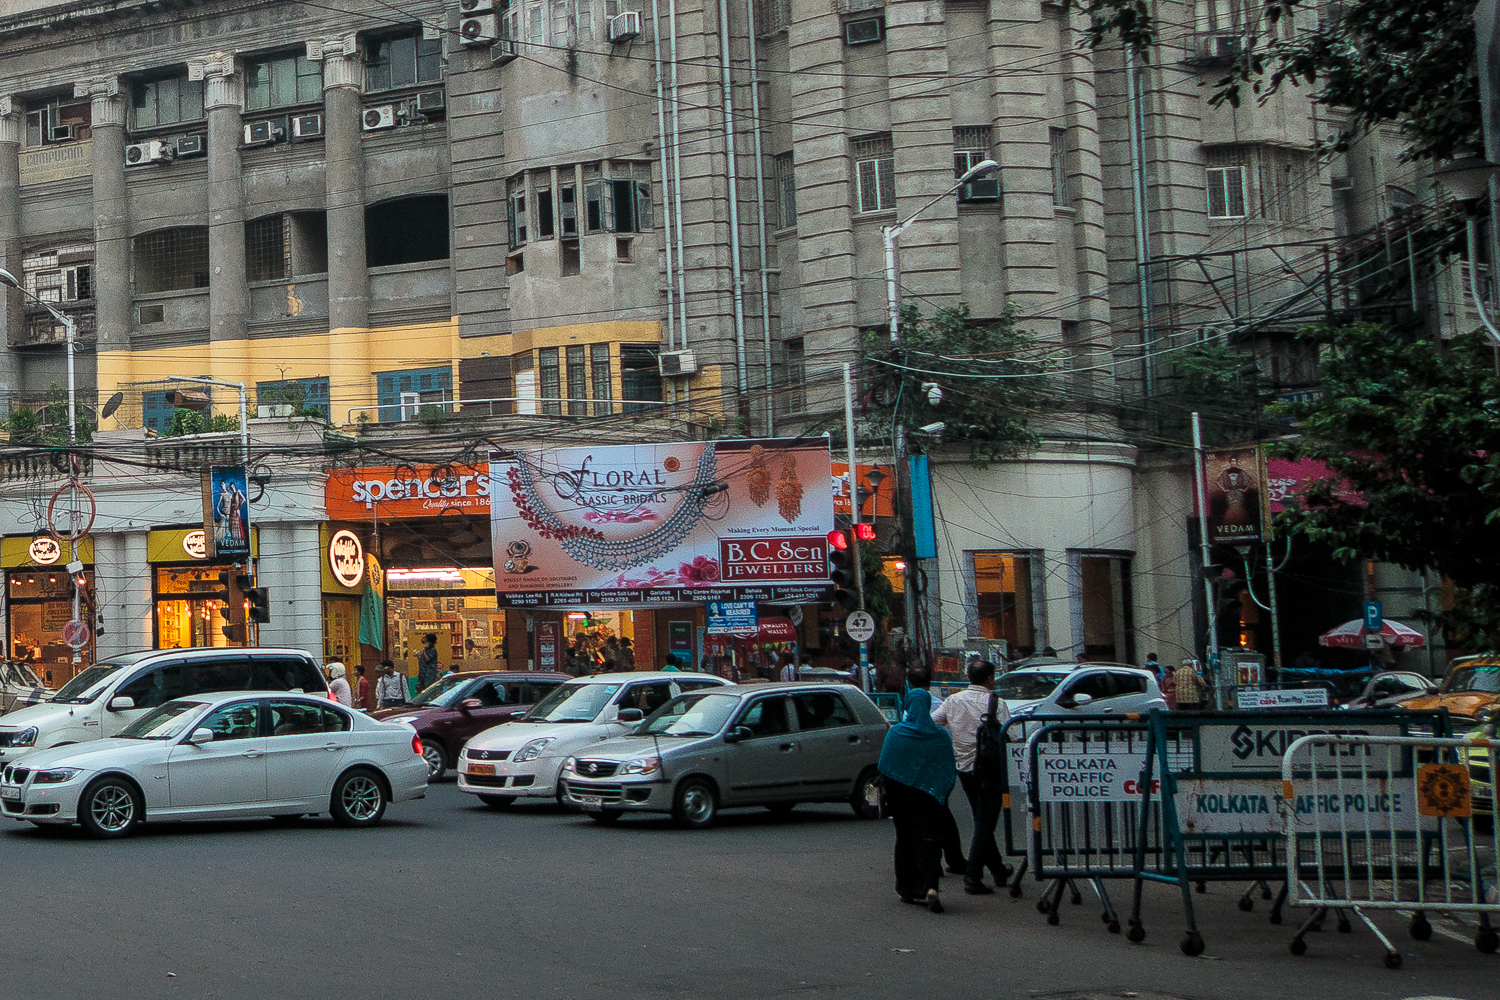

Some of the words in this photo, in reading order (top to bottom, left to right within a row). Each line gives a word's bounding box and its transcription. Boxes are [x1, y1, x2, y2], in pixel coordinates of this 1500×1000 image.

[351, 471, 491, 509] spencer's
[450, 498, 472, 507] since
[474, 498, 491, 506] 186
[575, 494, 617, 506] CLASSIC
[623, 493, 667, 504] BRIDALS
[1216, 524, 1254, 533] VEDAM
[220, 539, 246, 547] VEDAM
[334, 538, 356, 560] Waffle
[727, 543, 747, 562] B.
[750, 541, 774, 561] C.
[777, 540, 823, 561] Sen
[727, 564, 824, 578] JEWELLERS
[1367, 605, 1378, 626] P
[852, 618, 867, 627] 47
[1045, 758, 1118, 770] KOLKATA
[1047, 772, 1114, 783] TRAFFIC
[1052, 785, 1111, 797] POLICE
[1196, 794, 1270, 814] KOLKATA
[1273, 794, 1341, 815] TAFFIC
[1345, 793, 1403, 813] POLICE
